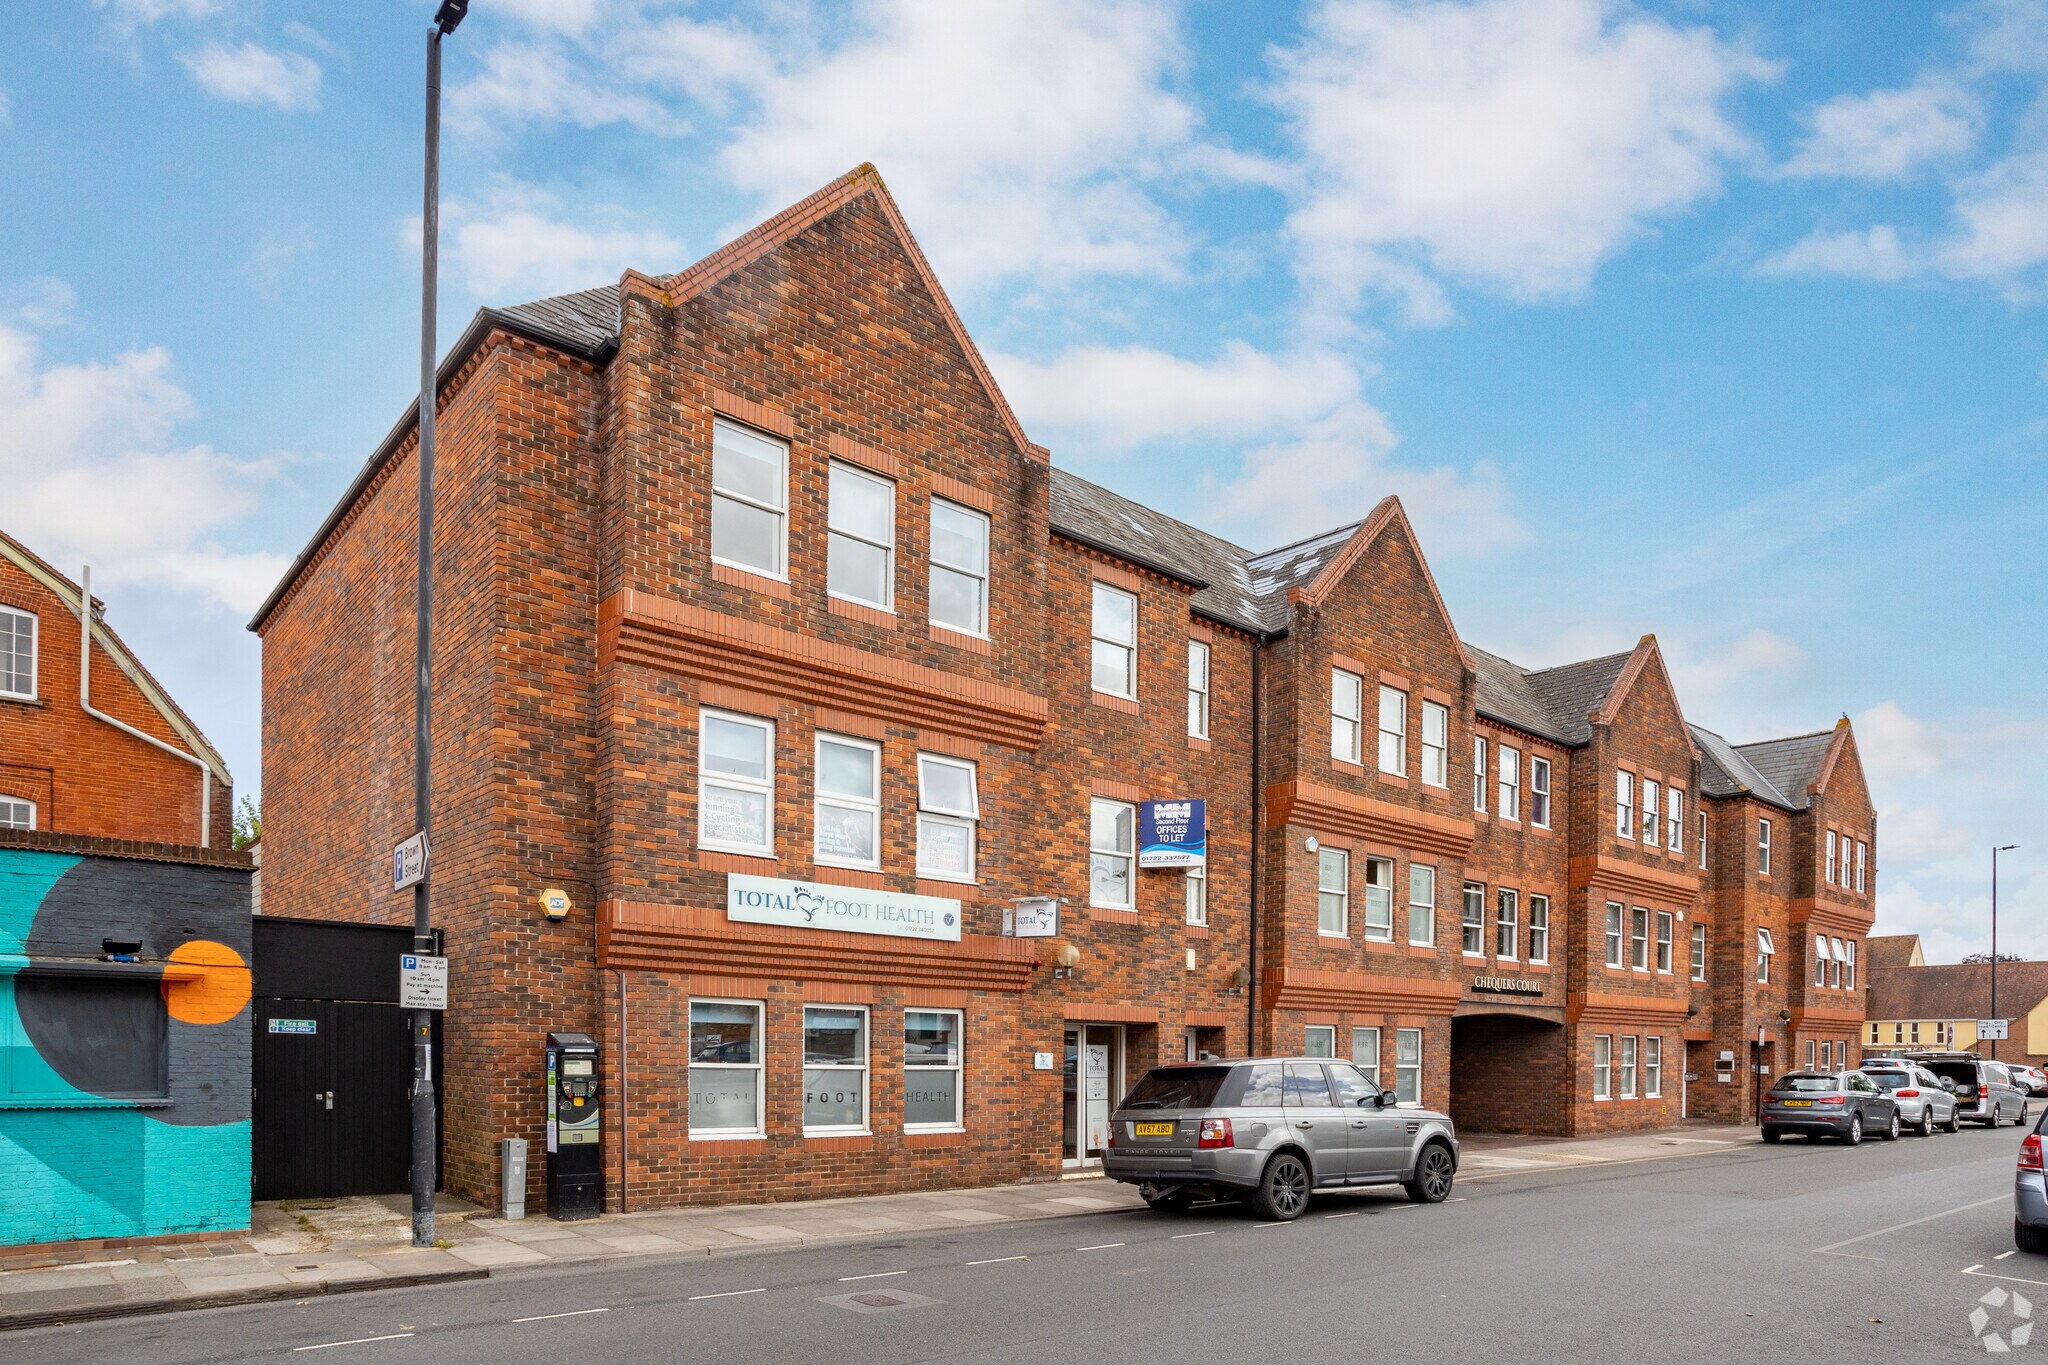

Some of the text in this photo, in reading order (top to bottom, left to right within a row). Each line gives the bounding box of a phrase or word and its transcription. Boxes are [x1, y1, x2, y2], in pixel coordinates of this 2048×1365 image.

[712, 812, 740, 826] Cycling
[1156, 825, 1188, 834] OFFICES
[1158, 834, 1185, 843] TO LET
[405, 844, 419, 860] Brown
[405, 862, 419, 878] Street
[551, 899, 564, 907] ADT
[734, 890, 934, 925] TOTAL FOOT HEALTH
[1018, 916, 1037, 925] TOTAL
[406, 957, 415, 968] P
[1475, 976, 1542, 992] CHEQUERS COURT
[421, 1027, 428, 1036] 7
[693, 1092, 752, 1105] TOTAL
[806, 1092, 858, 1104] FOOT
[906, 1091, 951, 1102] HEALTH
[1138, 1124, 1155, 1133] AV57
